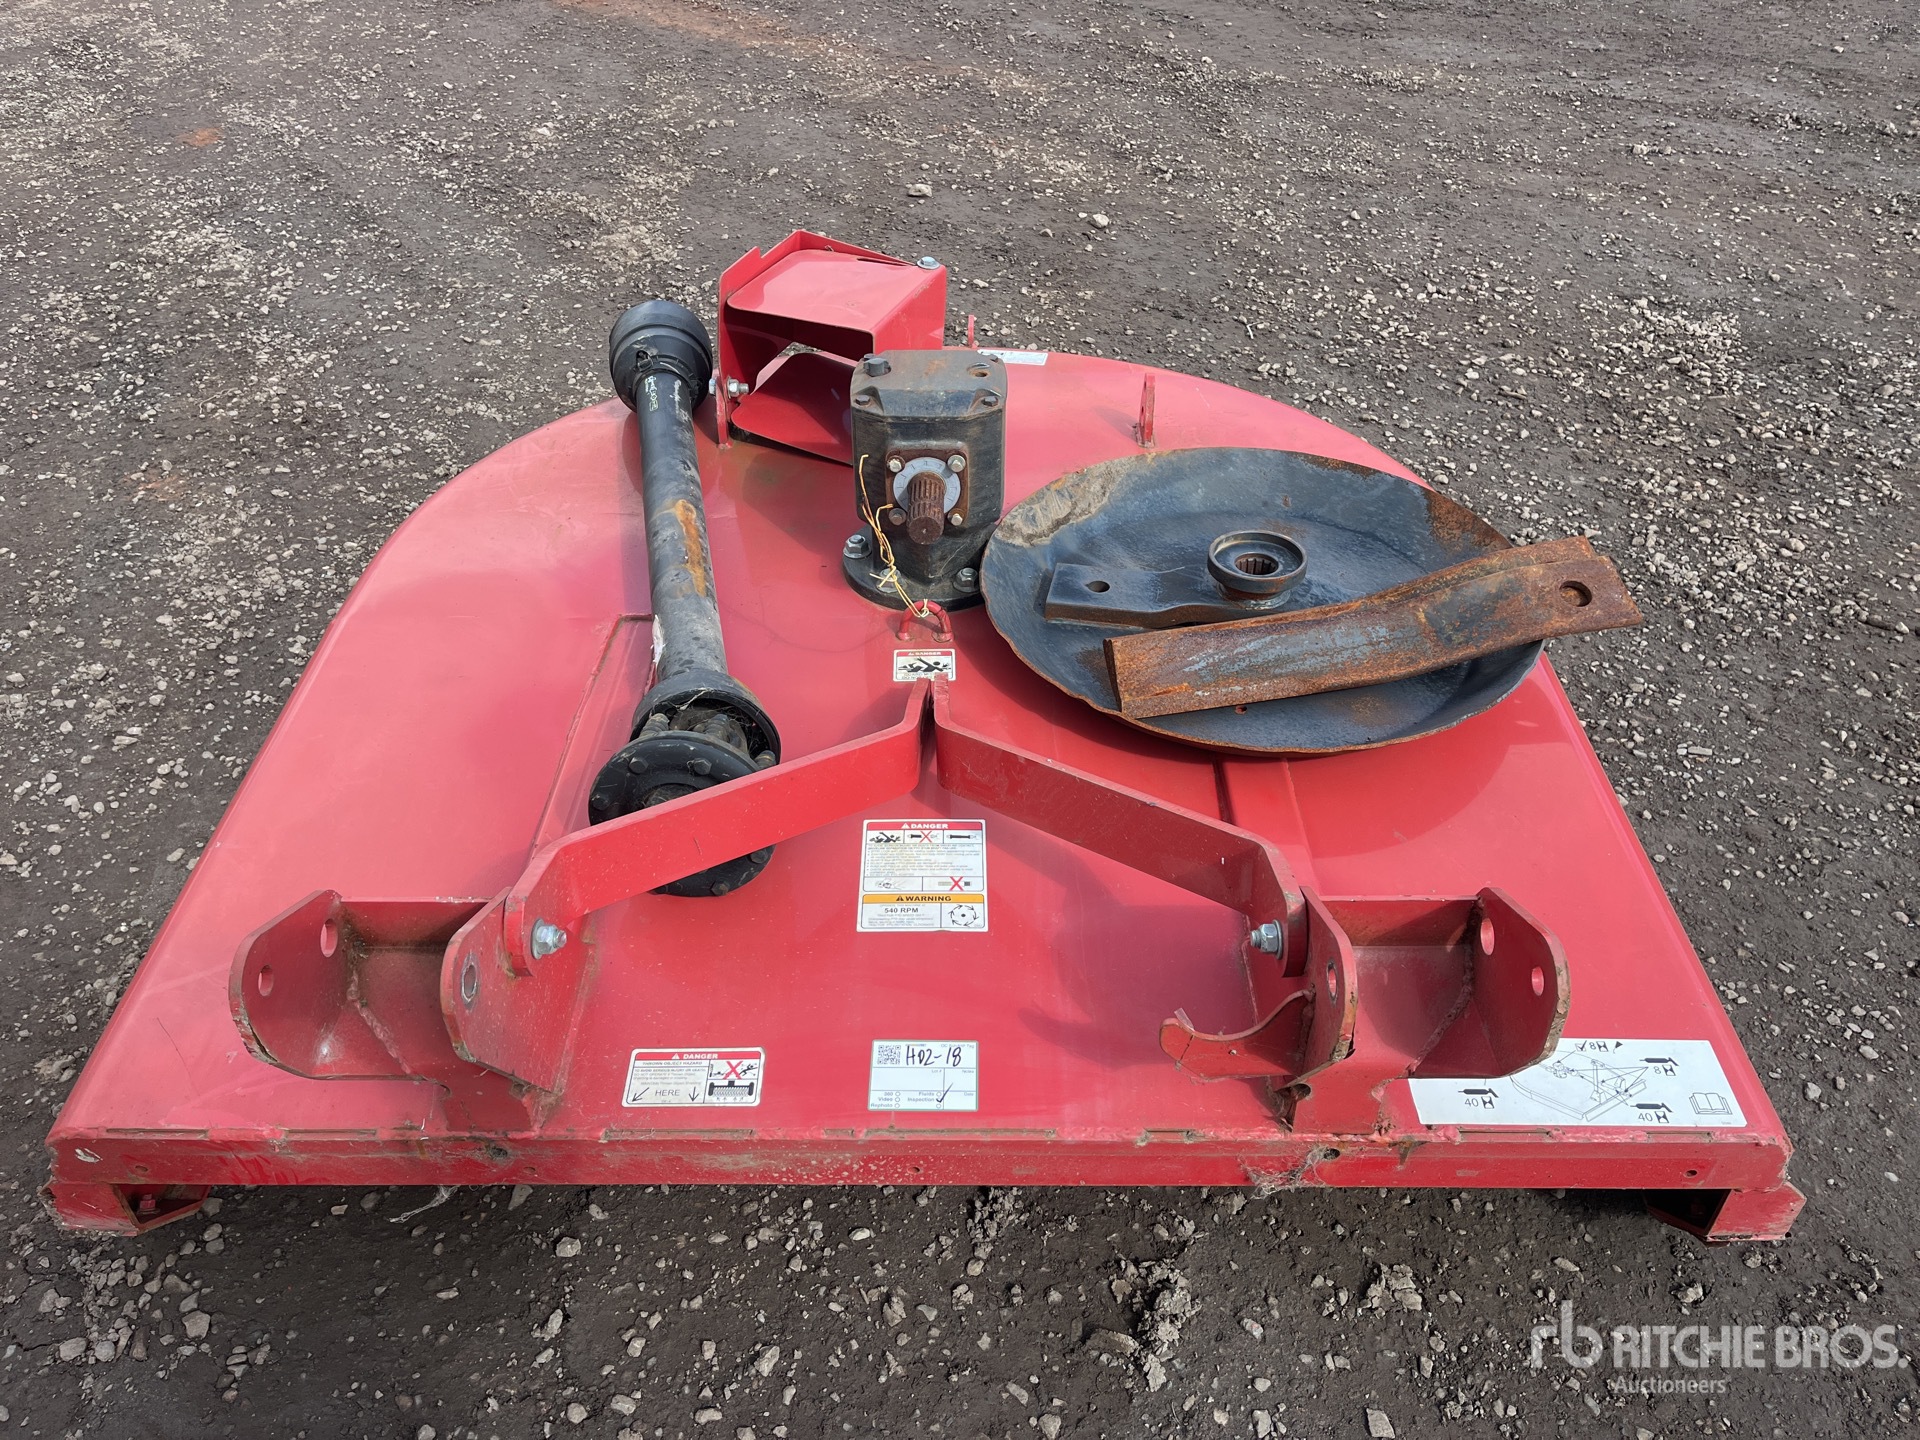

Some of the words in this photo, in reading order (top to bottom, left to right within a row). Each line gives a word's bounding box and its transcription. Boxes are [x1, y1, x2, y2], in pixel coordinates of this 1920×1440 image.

[1589, 1041, 1597, 1051] 8
[1653, 1065, 1662, 1075] 8
[655, 1089, 681, 1097] HERE
[1464, 1097, 1479, 1108] 40
[1637, 1112, 1654, 1122] 40
